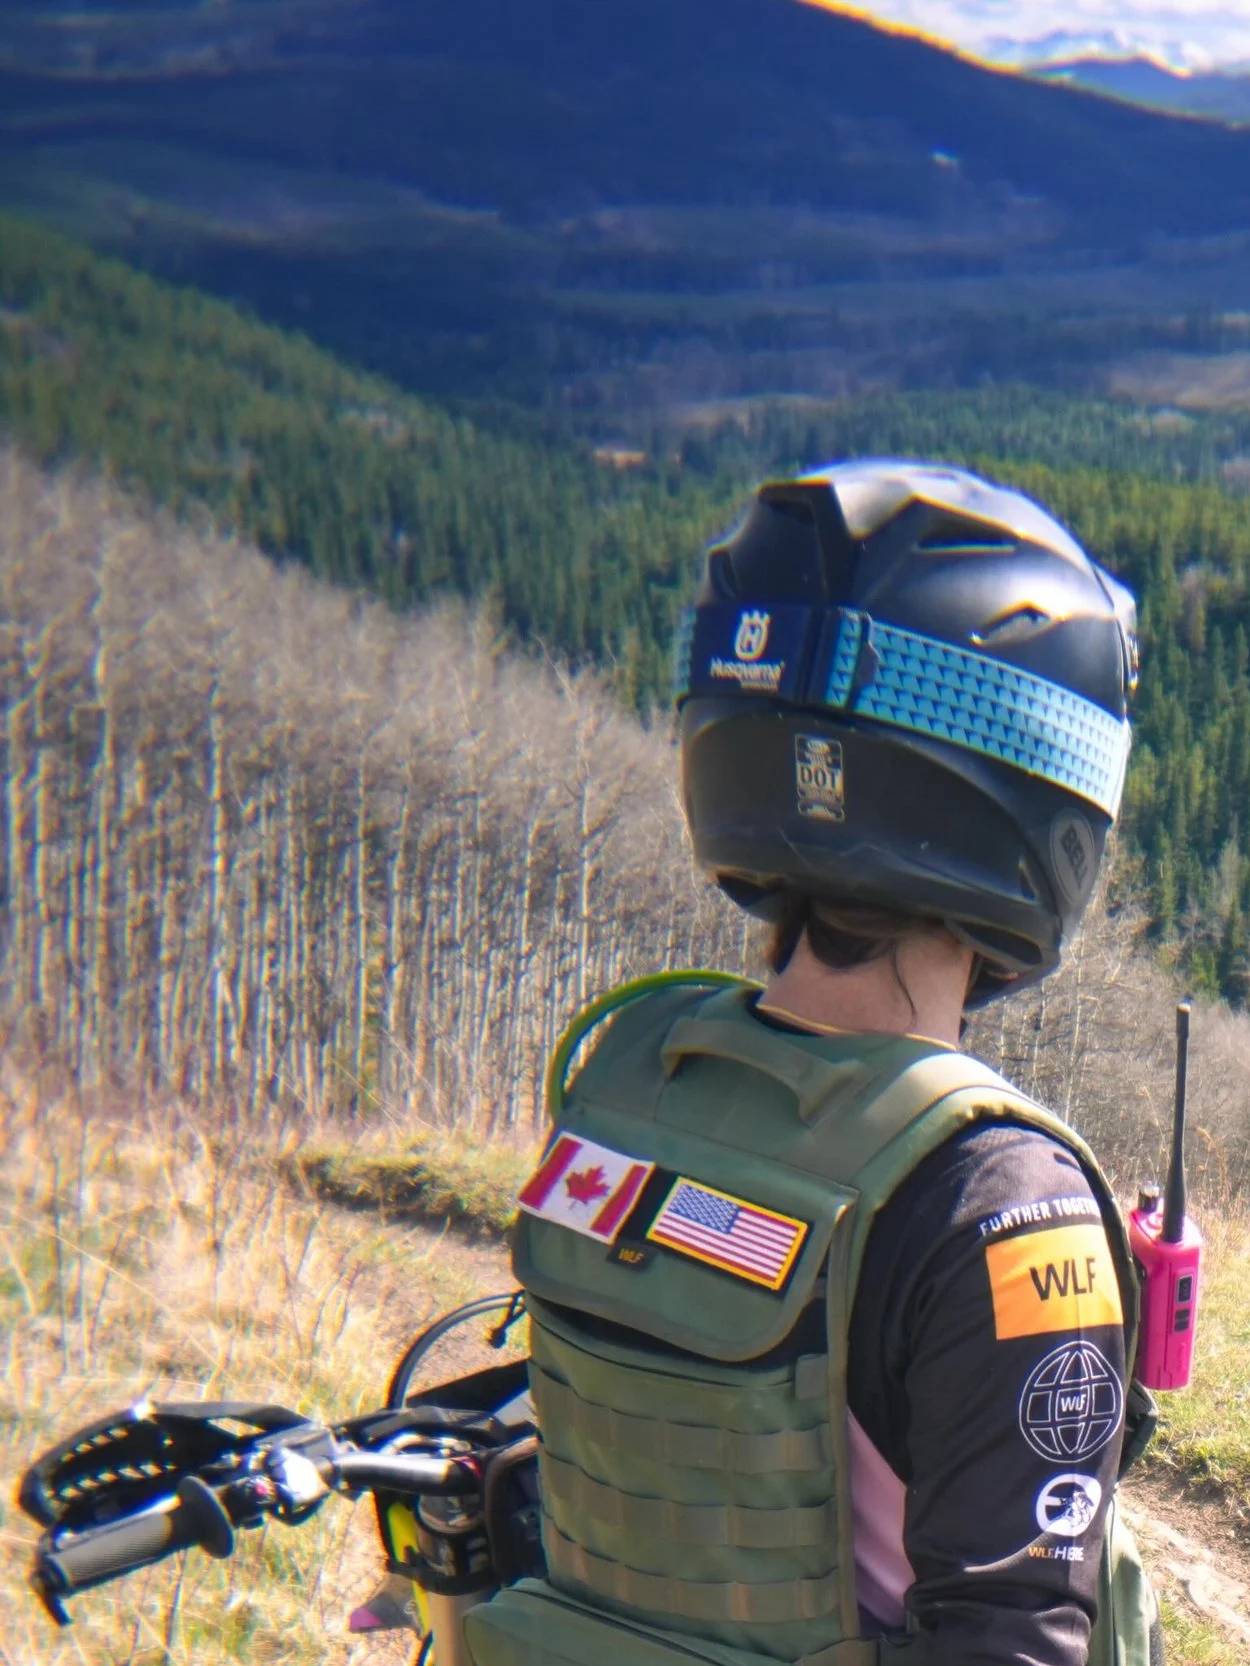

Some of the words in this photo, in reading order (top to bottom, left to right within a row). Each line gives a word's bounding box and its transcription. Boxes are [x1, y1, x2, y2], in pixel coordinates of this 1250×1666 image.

[800, 766, 838, 789] DOT
[979, 1201, 1052, 1237] FURTHER
[1029, 1256, 1096, 1302] WLF
[1060, 1393, 1087, 1412] WLF
